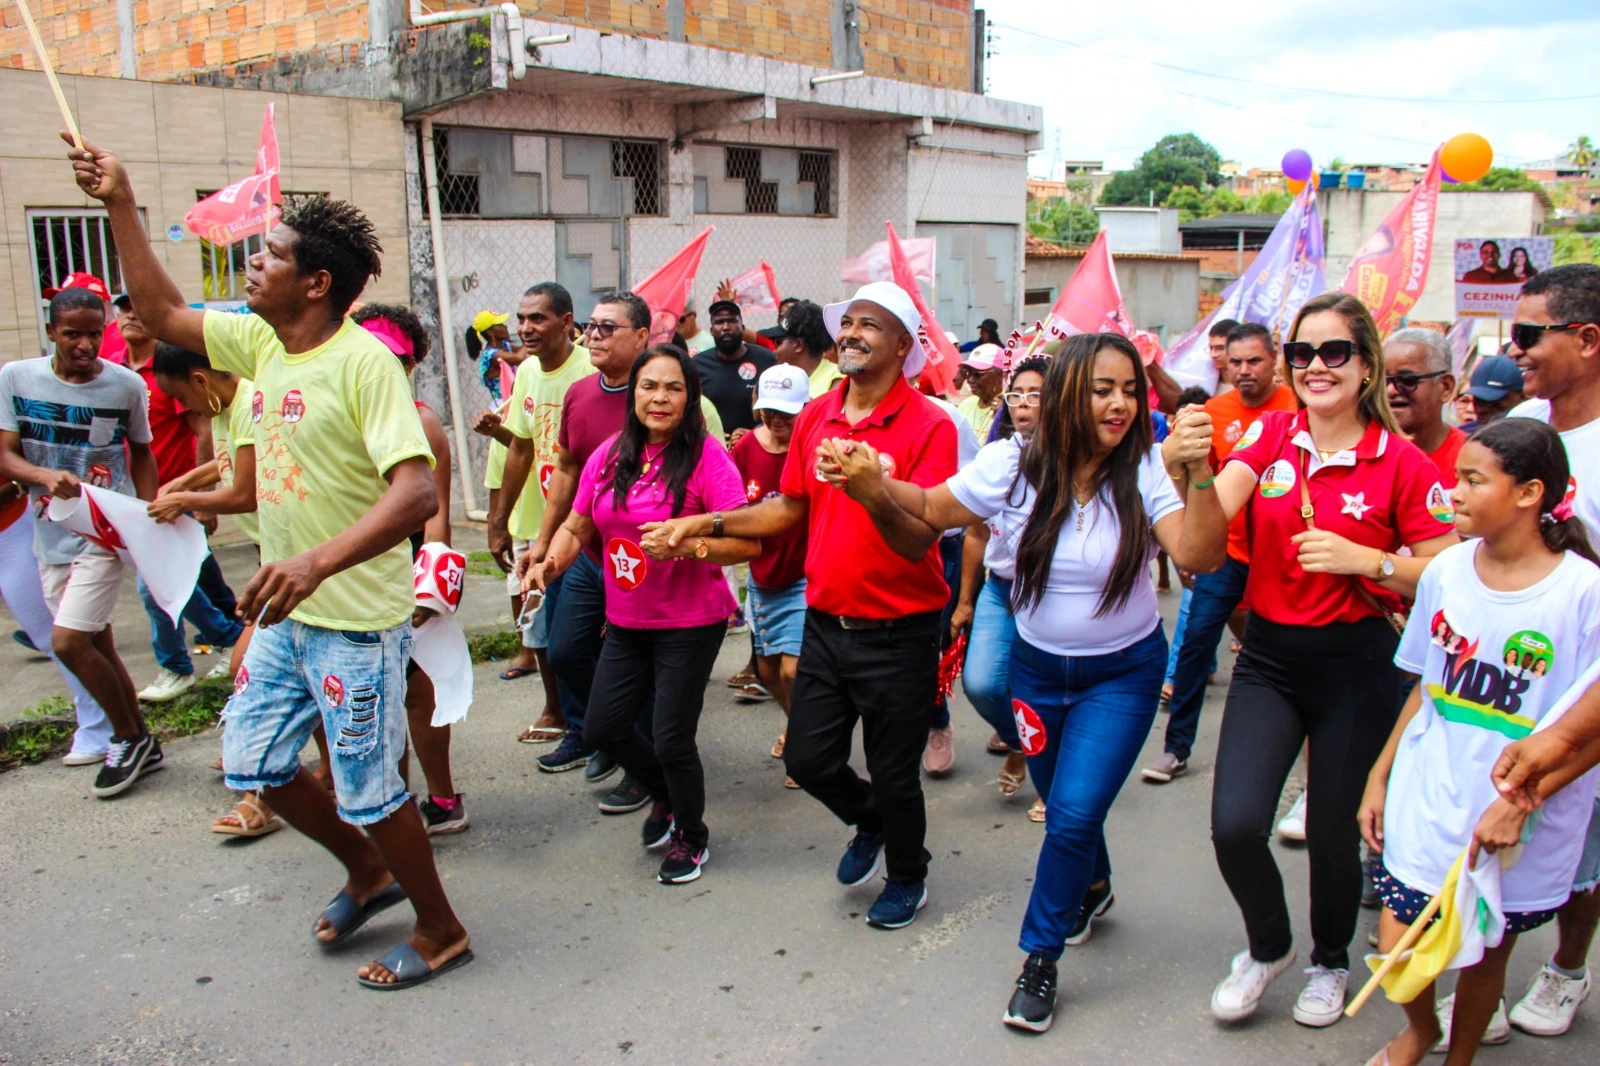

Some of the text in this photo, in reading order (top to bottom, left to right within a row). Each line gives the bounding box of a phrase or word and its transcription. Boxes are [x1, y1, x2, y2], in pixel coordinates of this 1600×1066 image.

[462, 271, 479, 293] 06
[617, 557, 630, 573] 13
[449, 569, 460, 586] 13
[1441, 652, 1530, 715] MDB
